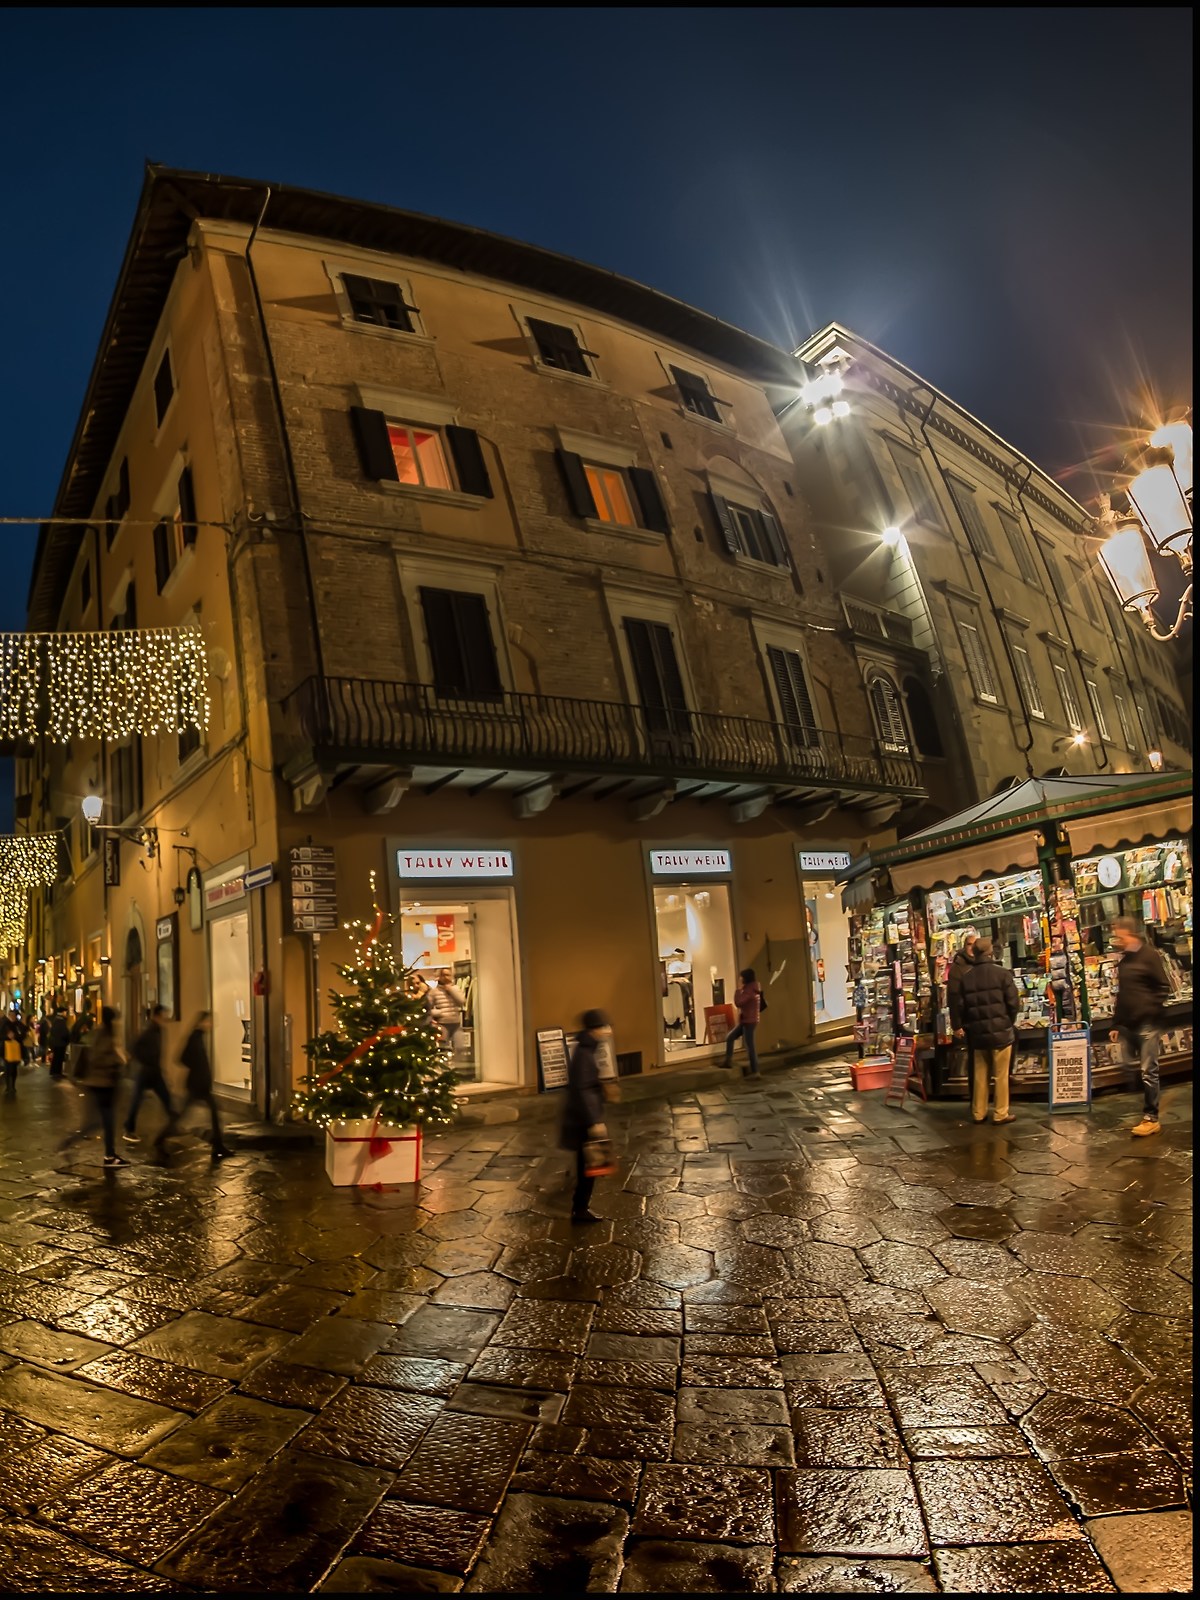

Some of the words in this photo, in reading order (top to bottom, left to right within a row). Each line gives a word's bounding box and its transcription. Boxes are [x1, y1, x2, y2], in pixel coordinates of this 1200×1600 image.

[404, 857, 453, 868] TALLY
[657, 855, 689, 866] TALLY
[802, 856, 824, 866] TALLY
[1057, 1058, 1083, 1066] MUORE
[1057, 1067, 1083, 1075] STORICO
